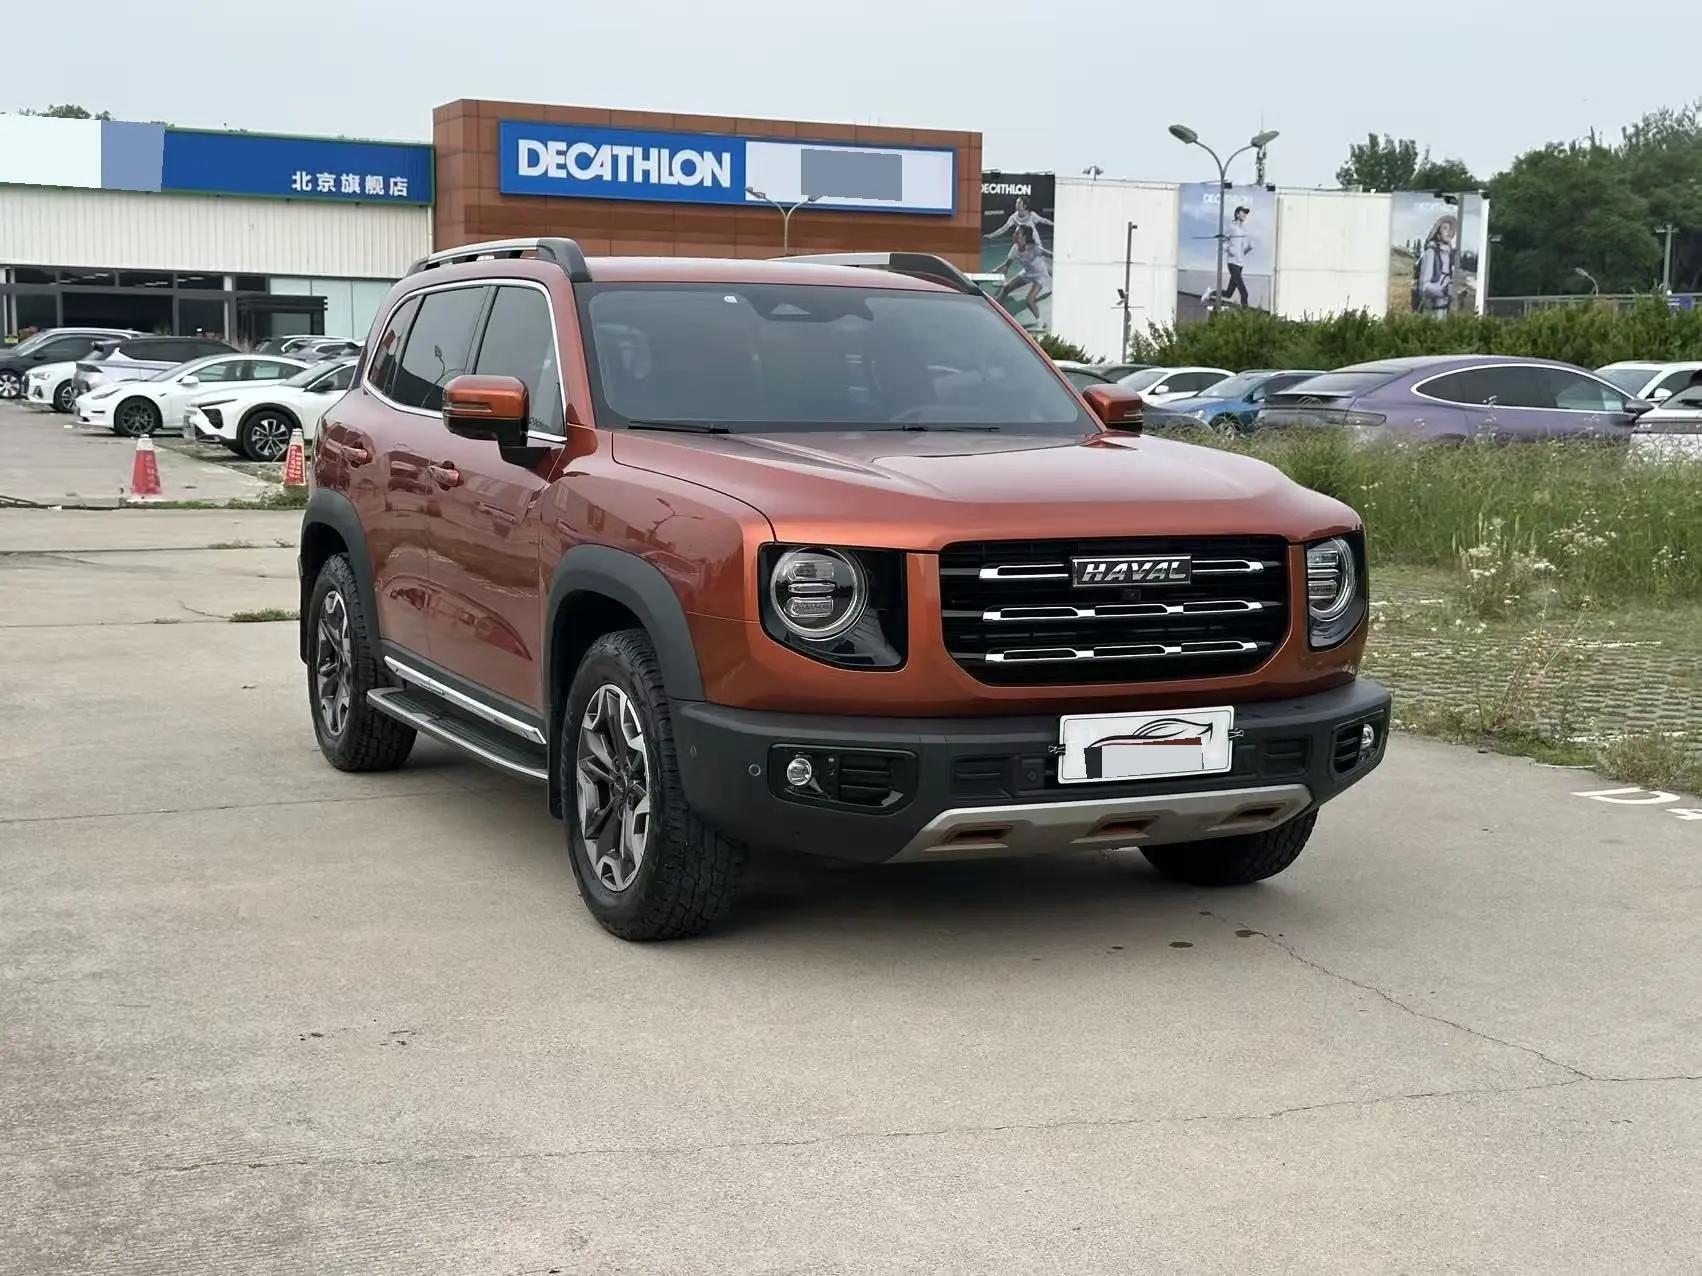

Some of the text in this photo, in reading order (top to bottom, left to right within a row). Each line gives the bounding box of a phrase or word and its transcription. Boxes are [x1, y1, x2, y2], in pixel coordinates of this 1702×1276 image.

[518, 138, 731, 187] DECATHLON
[291, 170, 408, 197] 北京旗舰店
[1081, 561, 1186, 582] HAVAL
